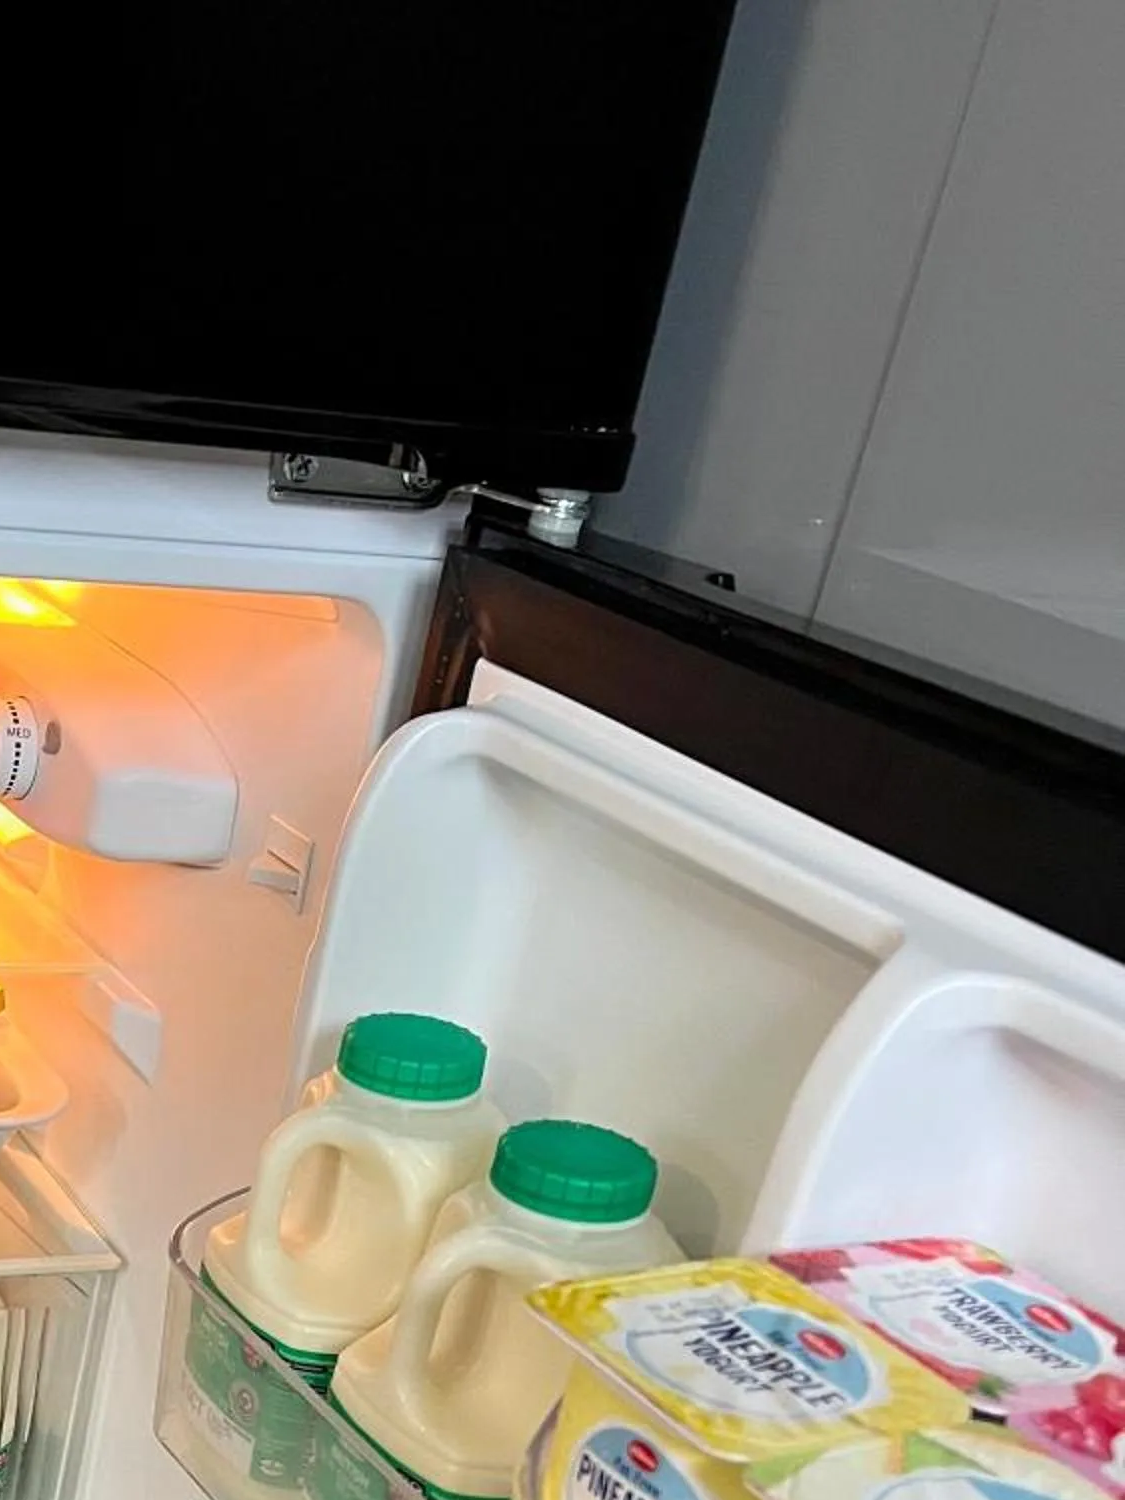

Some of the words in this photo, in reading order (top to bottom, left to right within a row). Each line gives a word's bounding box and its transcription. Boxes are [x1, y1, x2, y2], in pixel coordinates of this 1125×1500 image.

[6, 726, 31, 739] MED
[932, 1304, 1016, 1352] YOGURT
[939, 1282, 1083, 1370] TRAWBERRY
[683, 1336, 774, 1394] YOGURT
[697, 1307, 848, 1412] PINEAPPLE
